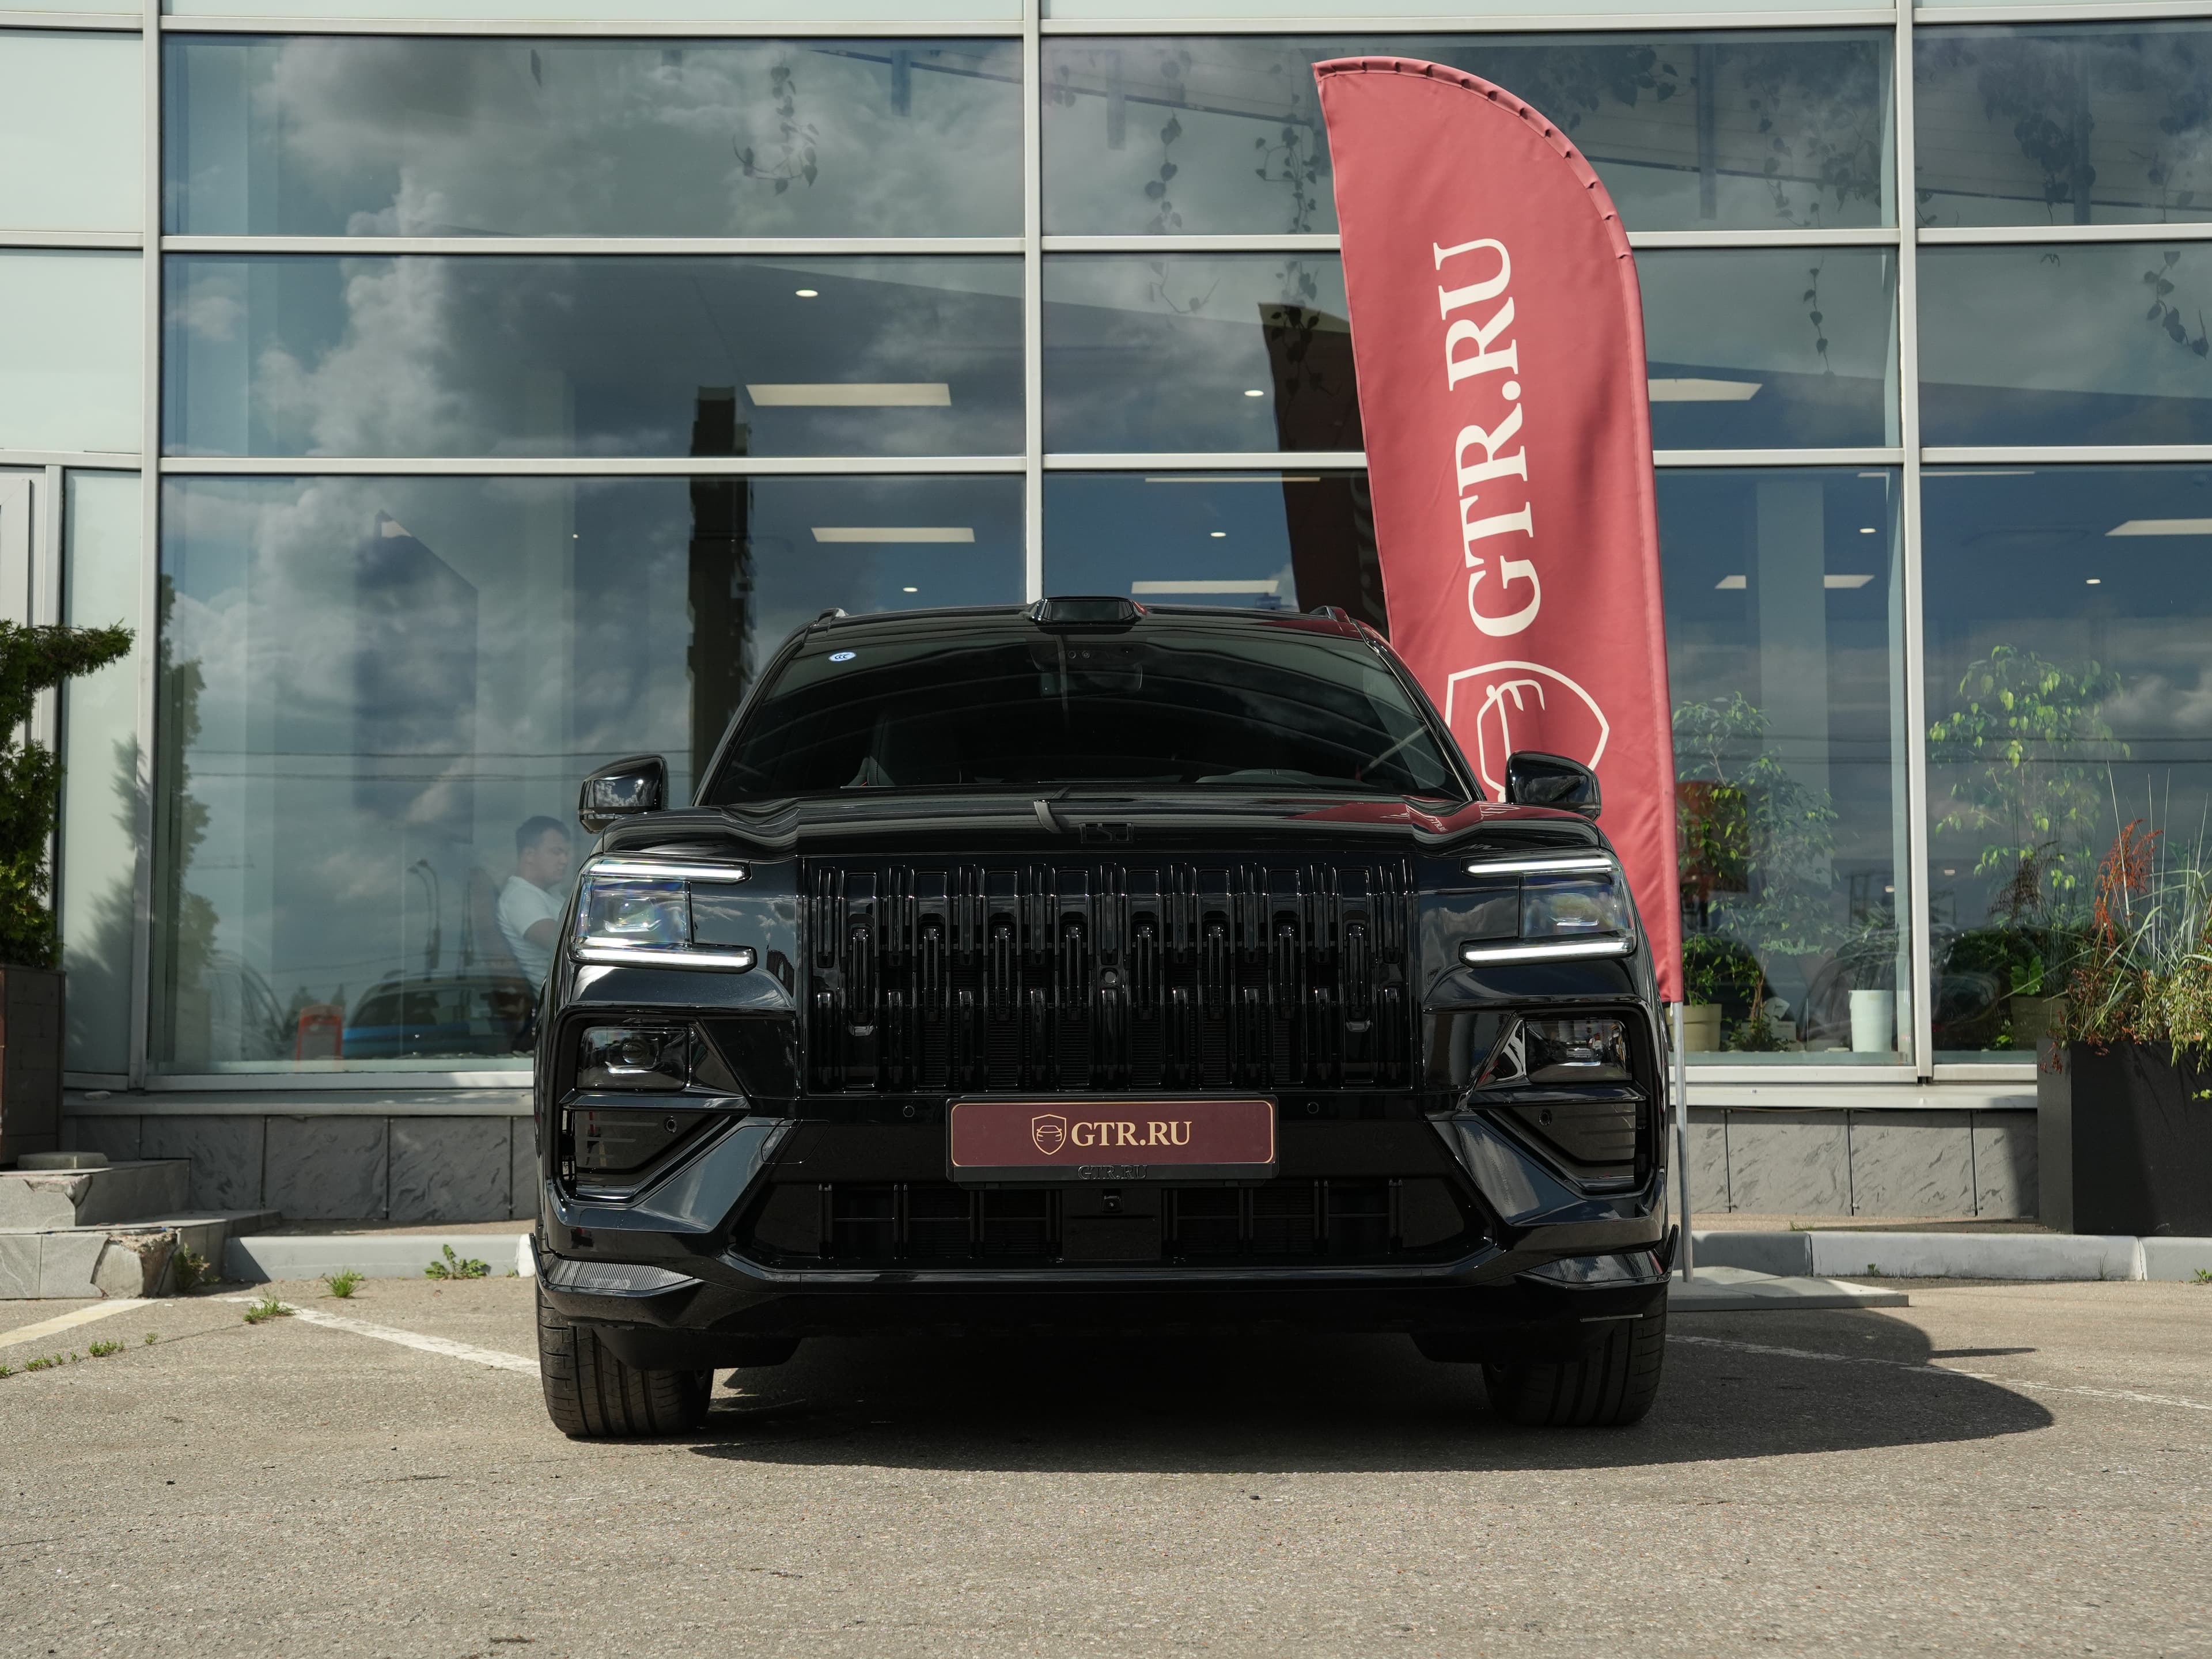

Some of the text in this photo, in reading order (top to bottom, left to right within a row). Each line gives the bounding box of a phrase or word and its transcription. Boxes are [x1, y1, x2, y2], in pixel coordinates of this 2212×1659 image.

[1433, 237, 1541, 637] GTR.RU
[1071, 1121, 1192, 1146] GTR.RU
[1078, 1165, 1147, 1180] GTR.RU
